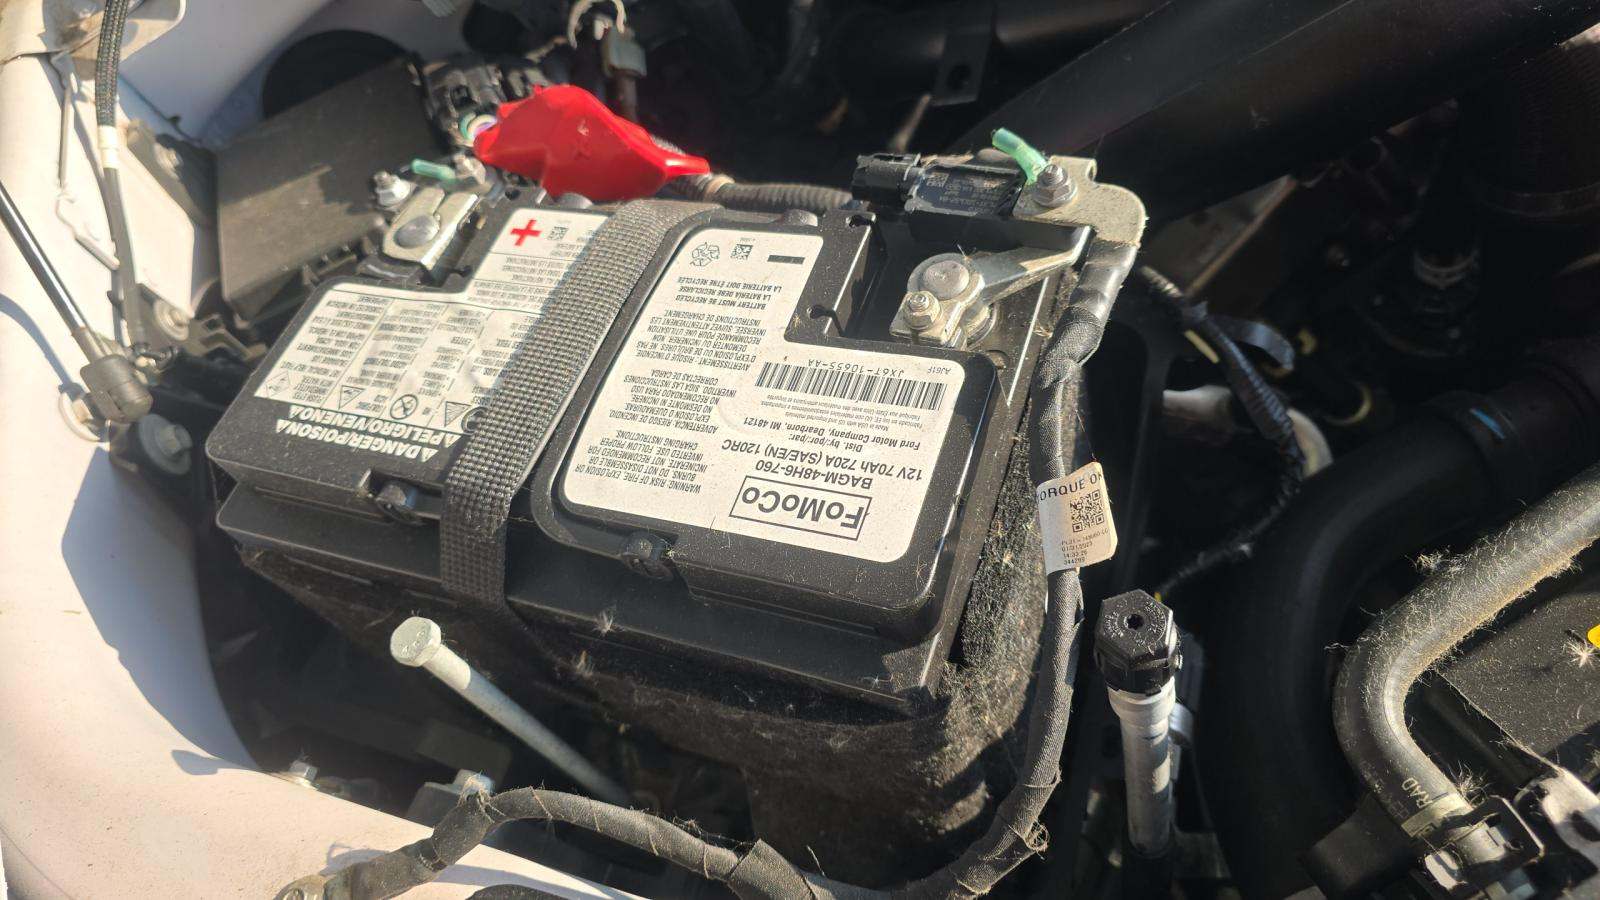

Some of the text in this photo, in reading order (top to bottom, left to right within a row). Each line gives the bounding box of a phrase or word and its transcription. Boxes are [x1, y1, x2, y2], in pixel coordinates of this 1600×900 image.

[807, 359, 904, 377] JX6T-10655-AA
[297, 405, 446, 446] PELIGRO/VENENO
[284, 420, 422, 459] DANGER/POISON
[743, 417, 920, 450] Ford Motor Company, Dearborn, MI 48121
[599, 437, 626, 448] PROPER
[625, 442, 654, 453] FOLLOW
[663, 438, 698, 450] CHARGING
[844, 442, 863, 452] Dist.
[587, 445, 601, 454] FOR
[601, 447, 651, 463] RECOMMENDED
[670, 449, 703, 461] INVERTED
[588, 455, 599, 464] OR
[598, 457, 644, 472] DISASSEMBLE
[650, 456, 666, 465] NOT
[721, 439, 922, 480] 12V 70Ah 720A (SAE/EN) 120RC
[574, 463, 585, 472] OR
[584, 465, 621, 479] EXPLOSION
[642, 465, 659, 474] NOT
[658, 468, 670, 476] DO
[638, 475, 649, 484] OF
[755, 459, 873, 489] BAGM-48H6-760
[648, 477, 666, 487] RISK
[667, 480, 701, 493] WARNING:
[1037, 478, 1085, 501] ORQUE
[741, 486, 864, 529] FoMoCo
